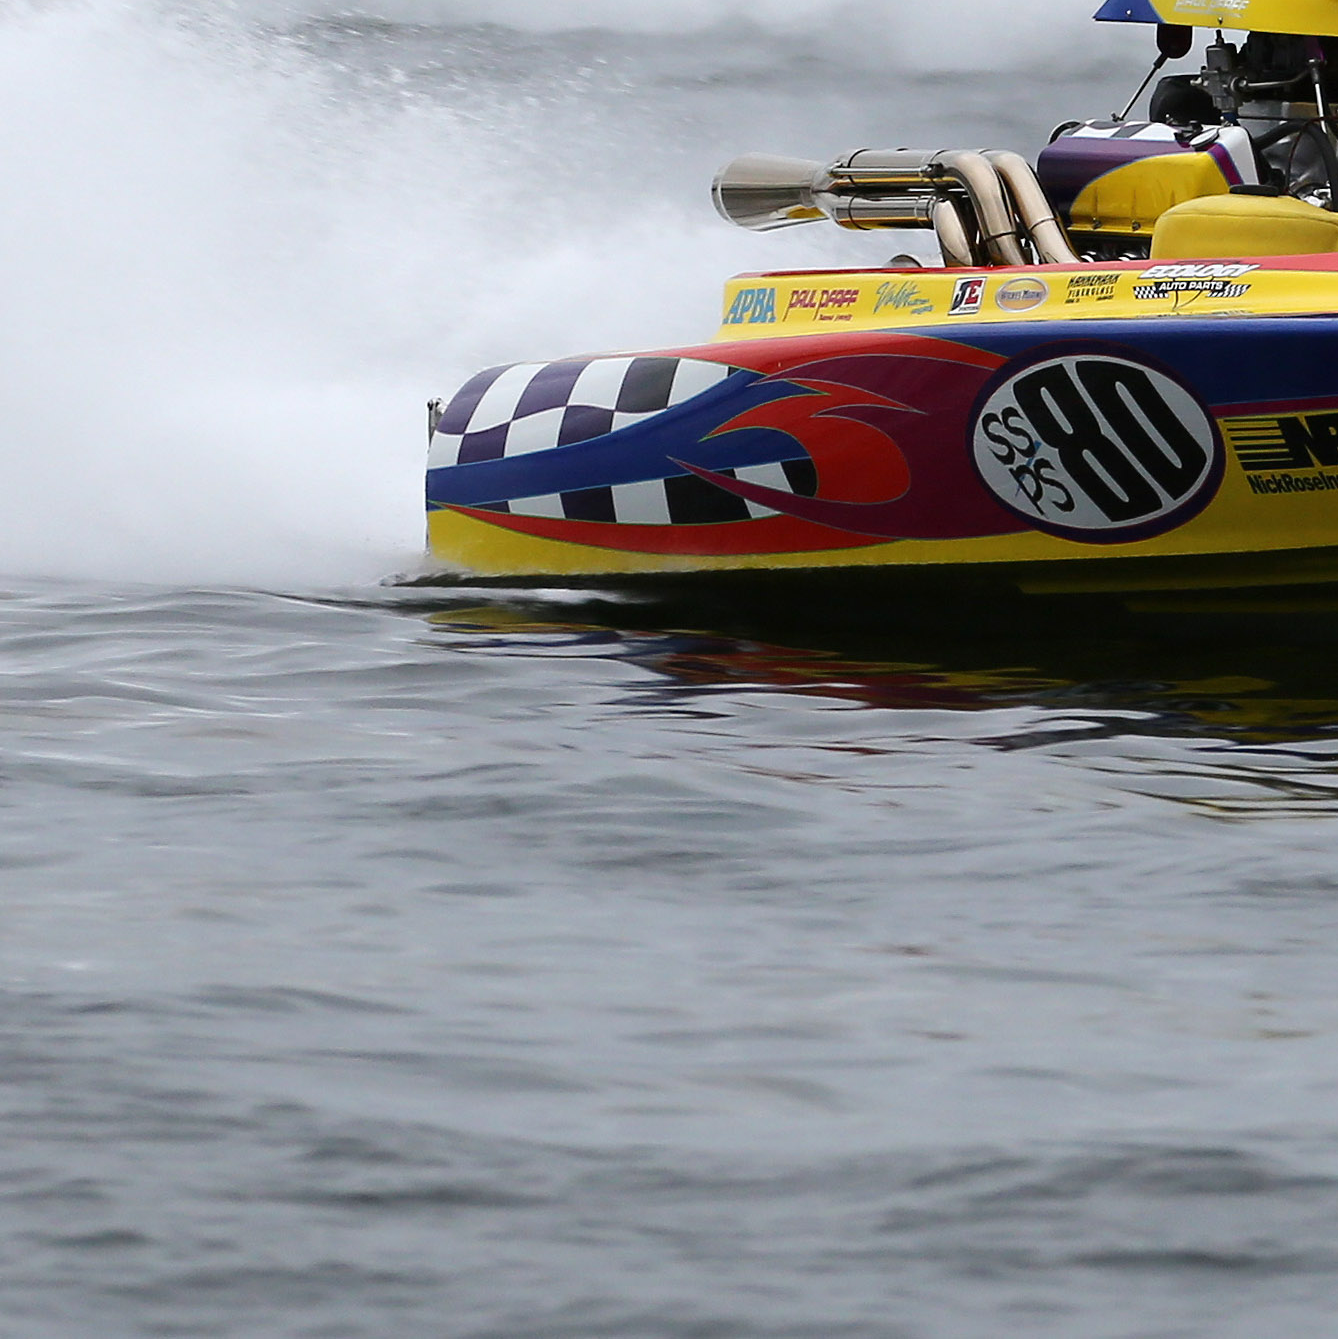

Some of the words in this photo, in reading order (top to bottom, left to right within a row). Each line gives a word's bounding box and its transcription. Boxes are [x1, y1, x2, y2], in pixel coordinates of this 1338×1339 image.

[1138, 264, 1261, 280] ECOLOGY
[1159, 282, 1186, 291] AUTO
[1188, 281, 1224, 290] PARTS
[722, 288, 777, 325] APBA
[982, 407, 1036, 465] SS
[1012, 360, 1208, 523] 80
